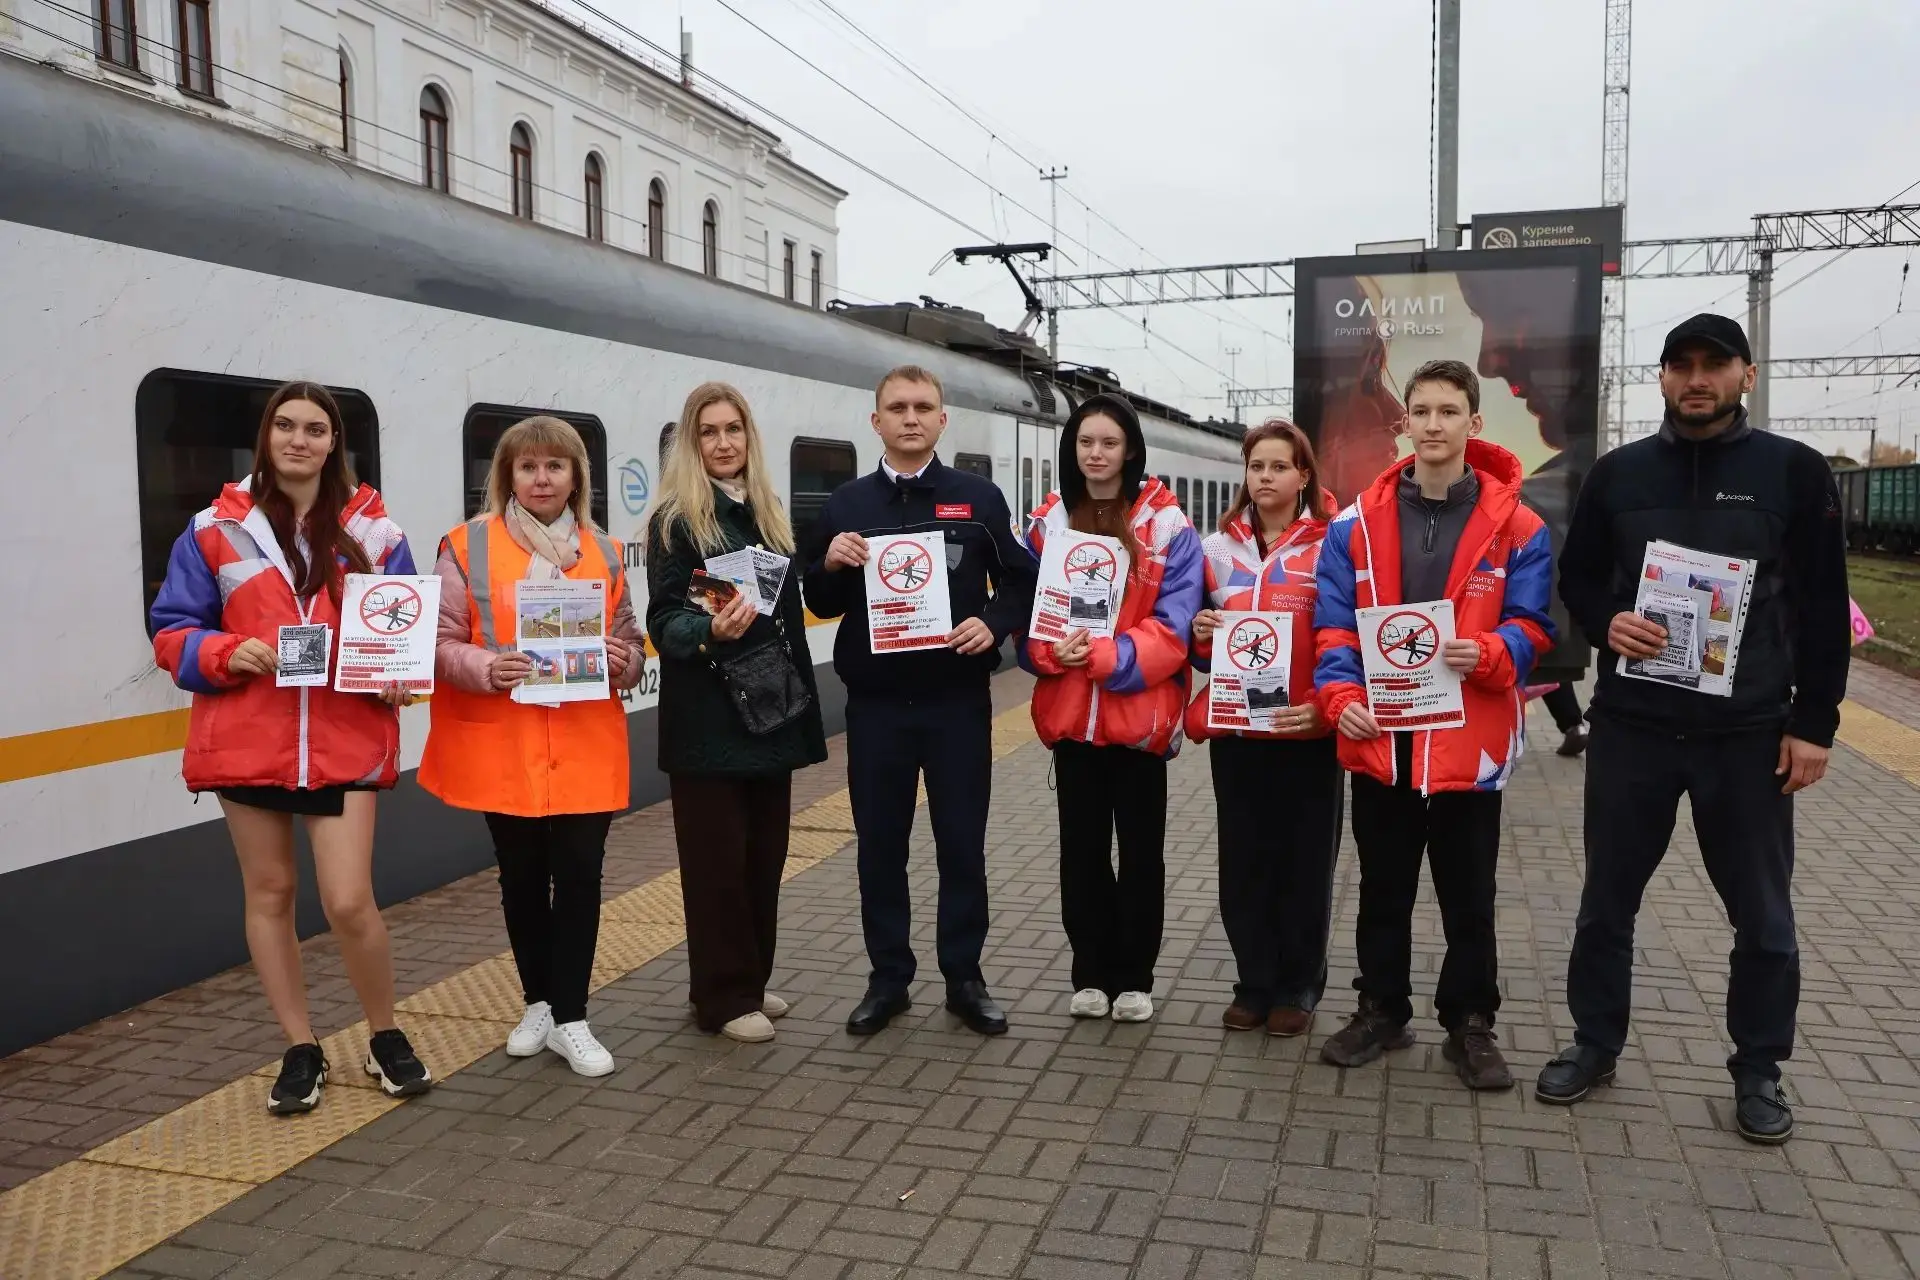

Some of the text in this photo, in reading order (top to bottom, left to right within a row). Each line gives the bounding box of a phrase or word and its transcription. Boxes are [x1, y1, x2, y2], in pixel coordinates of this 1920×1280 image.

[1522, 225, 1575, 238] Курение
[1335, 295, 1444, 318] ОЛИМП
[1335, 326, 1372, 337] ГРУППА
[1403, 321, 1444, 335] Russ
[343, 680, 378, 689] БЕРЕГИТЕ
[1377, 717, 1411, 727] БЕРЕГИТЕ
[1411, 715, 1431, 724] СВОЮ
